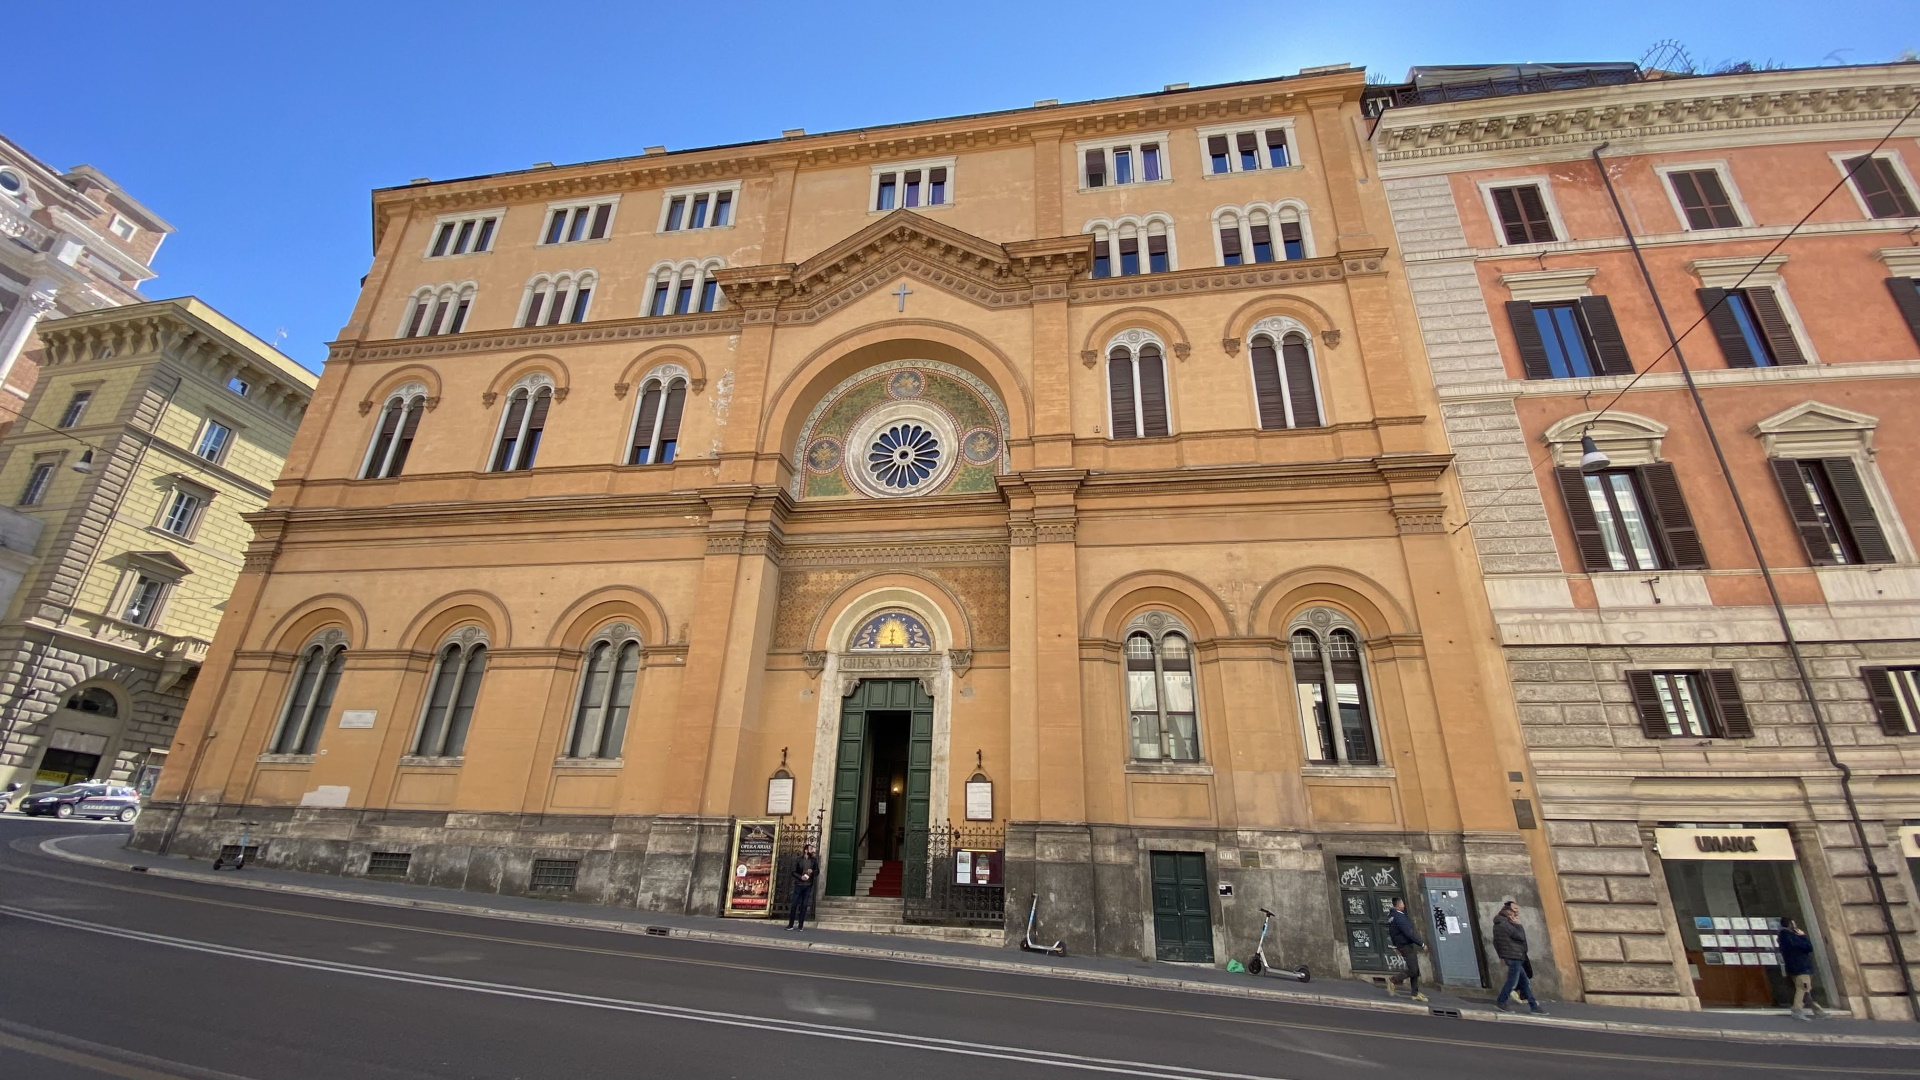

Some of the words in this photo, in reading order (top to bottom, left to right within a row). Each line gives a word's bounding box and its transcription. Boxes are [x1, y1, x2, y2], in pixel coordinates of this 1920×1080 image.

[843, 657, 882, 669] CHIESA
[888, 657, 939, 668] VALDESE
[1694, 835, 1758, 852] UMANA
